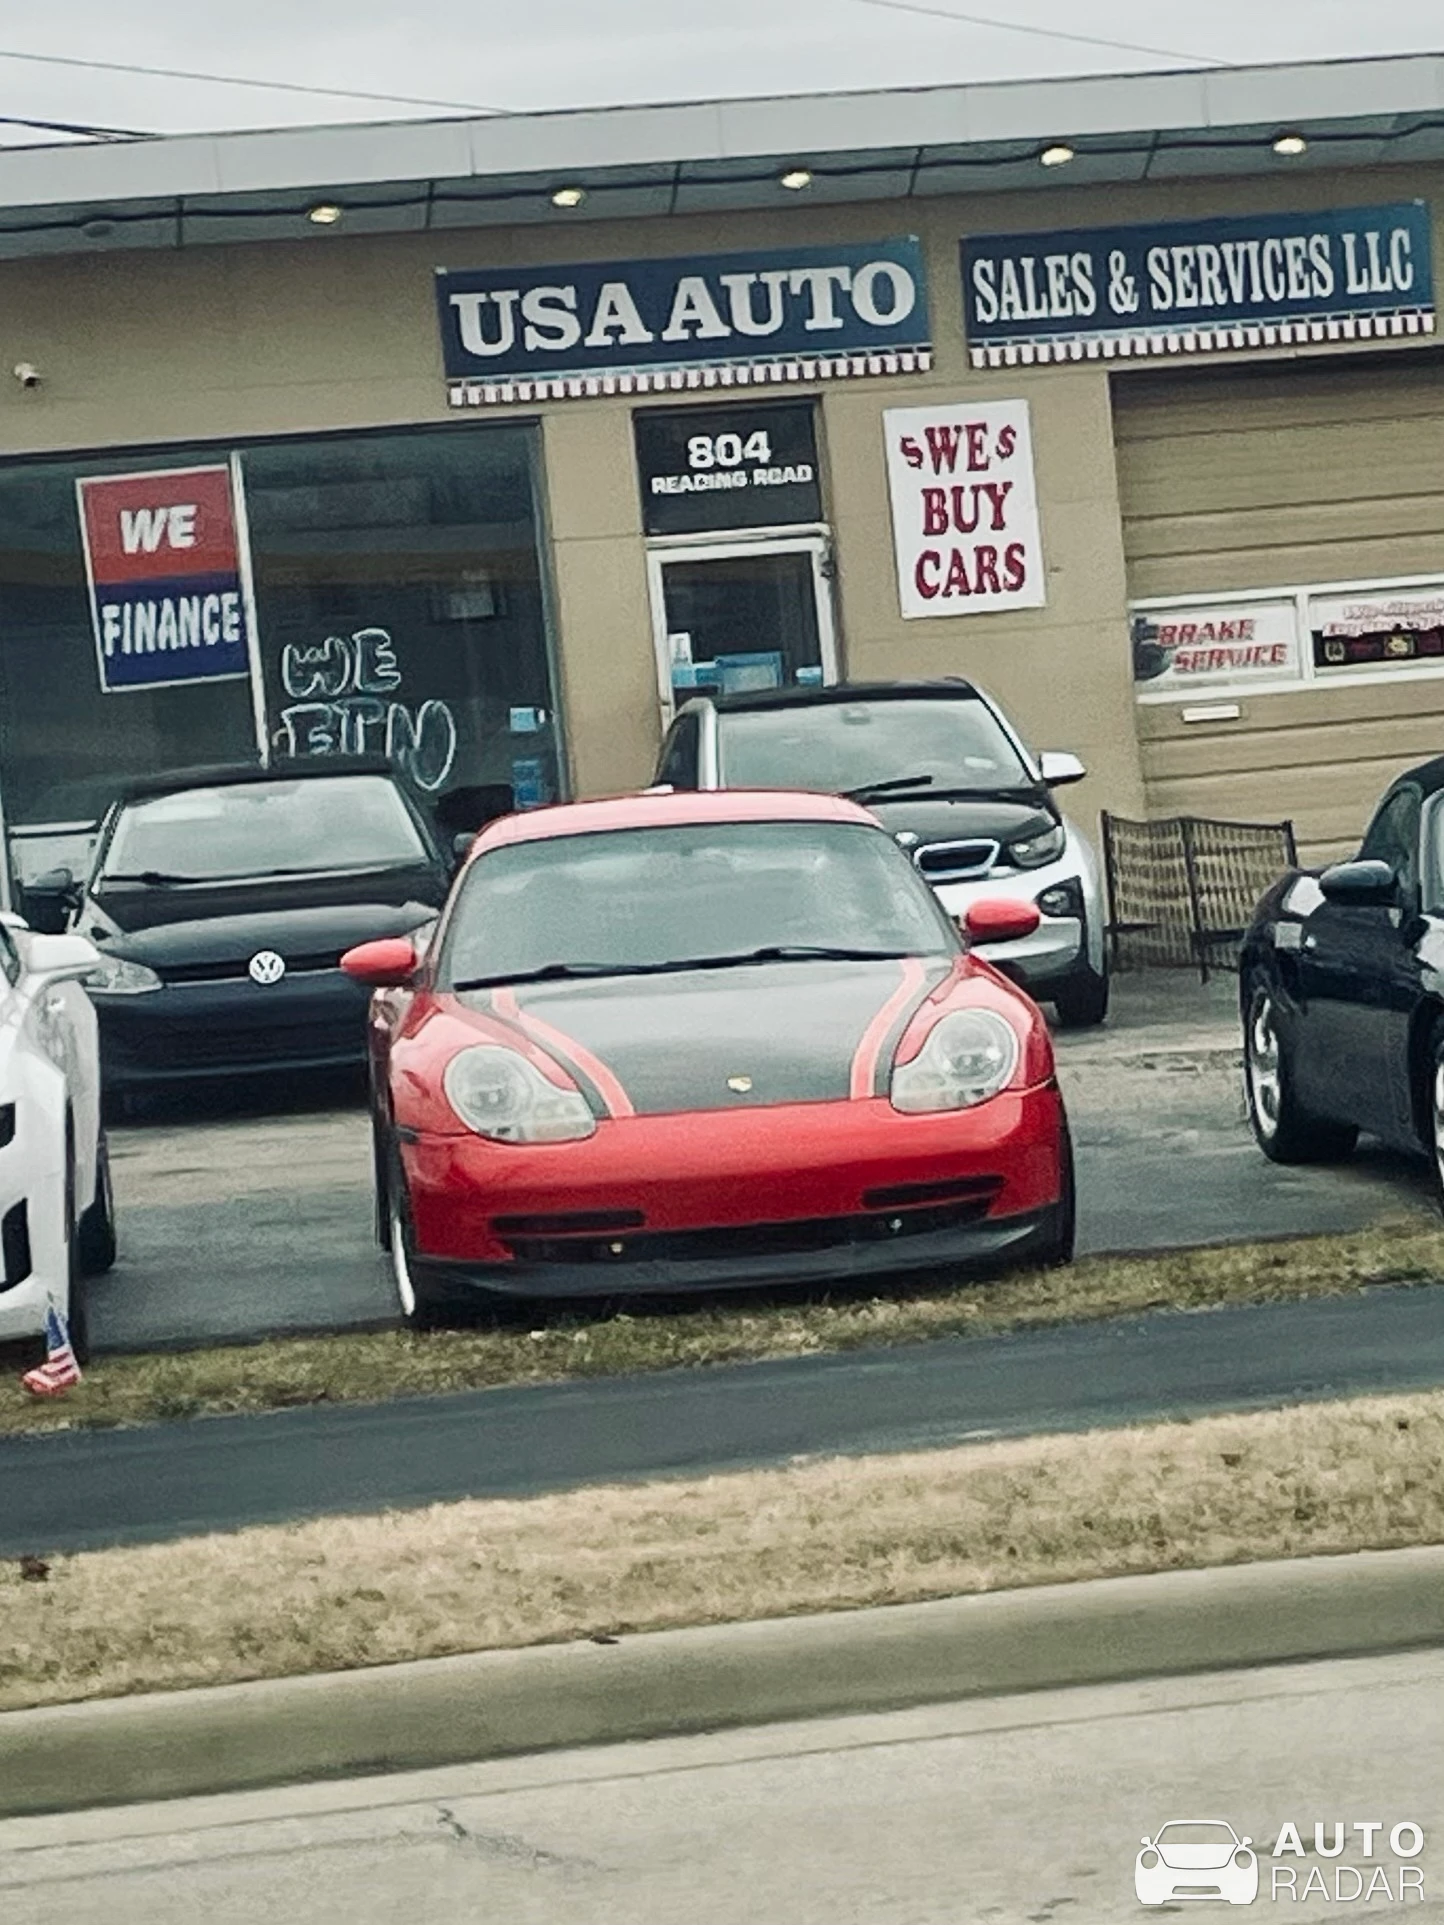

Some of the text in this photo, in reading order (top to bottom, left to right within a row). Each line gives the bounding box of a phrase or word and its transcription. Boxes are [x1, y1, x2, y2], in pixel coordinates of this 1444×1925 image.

[972, 228, 1414, 323] SALES & SERVICES LLC
[449, 260, 916, 357] USA AUTO
[687, 431, 772, 468] 804
[651, 464, 813, 495] READING ROAD
[120, 504, 198, 554] WE
[920, 481, 1013, 536] BUY
[914, 542, 1026, 600] CARS
[102, 592, 241, 657] FINANCE
[1158, 619, 1255, 647] BRAKE
[282, 628, 401, 698] WE
[1172, 643, 1288, 675] SERVICE
